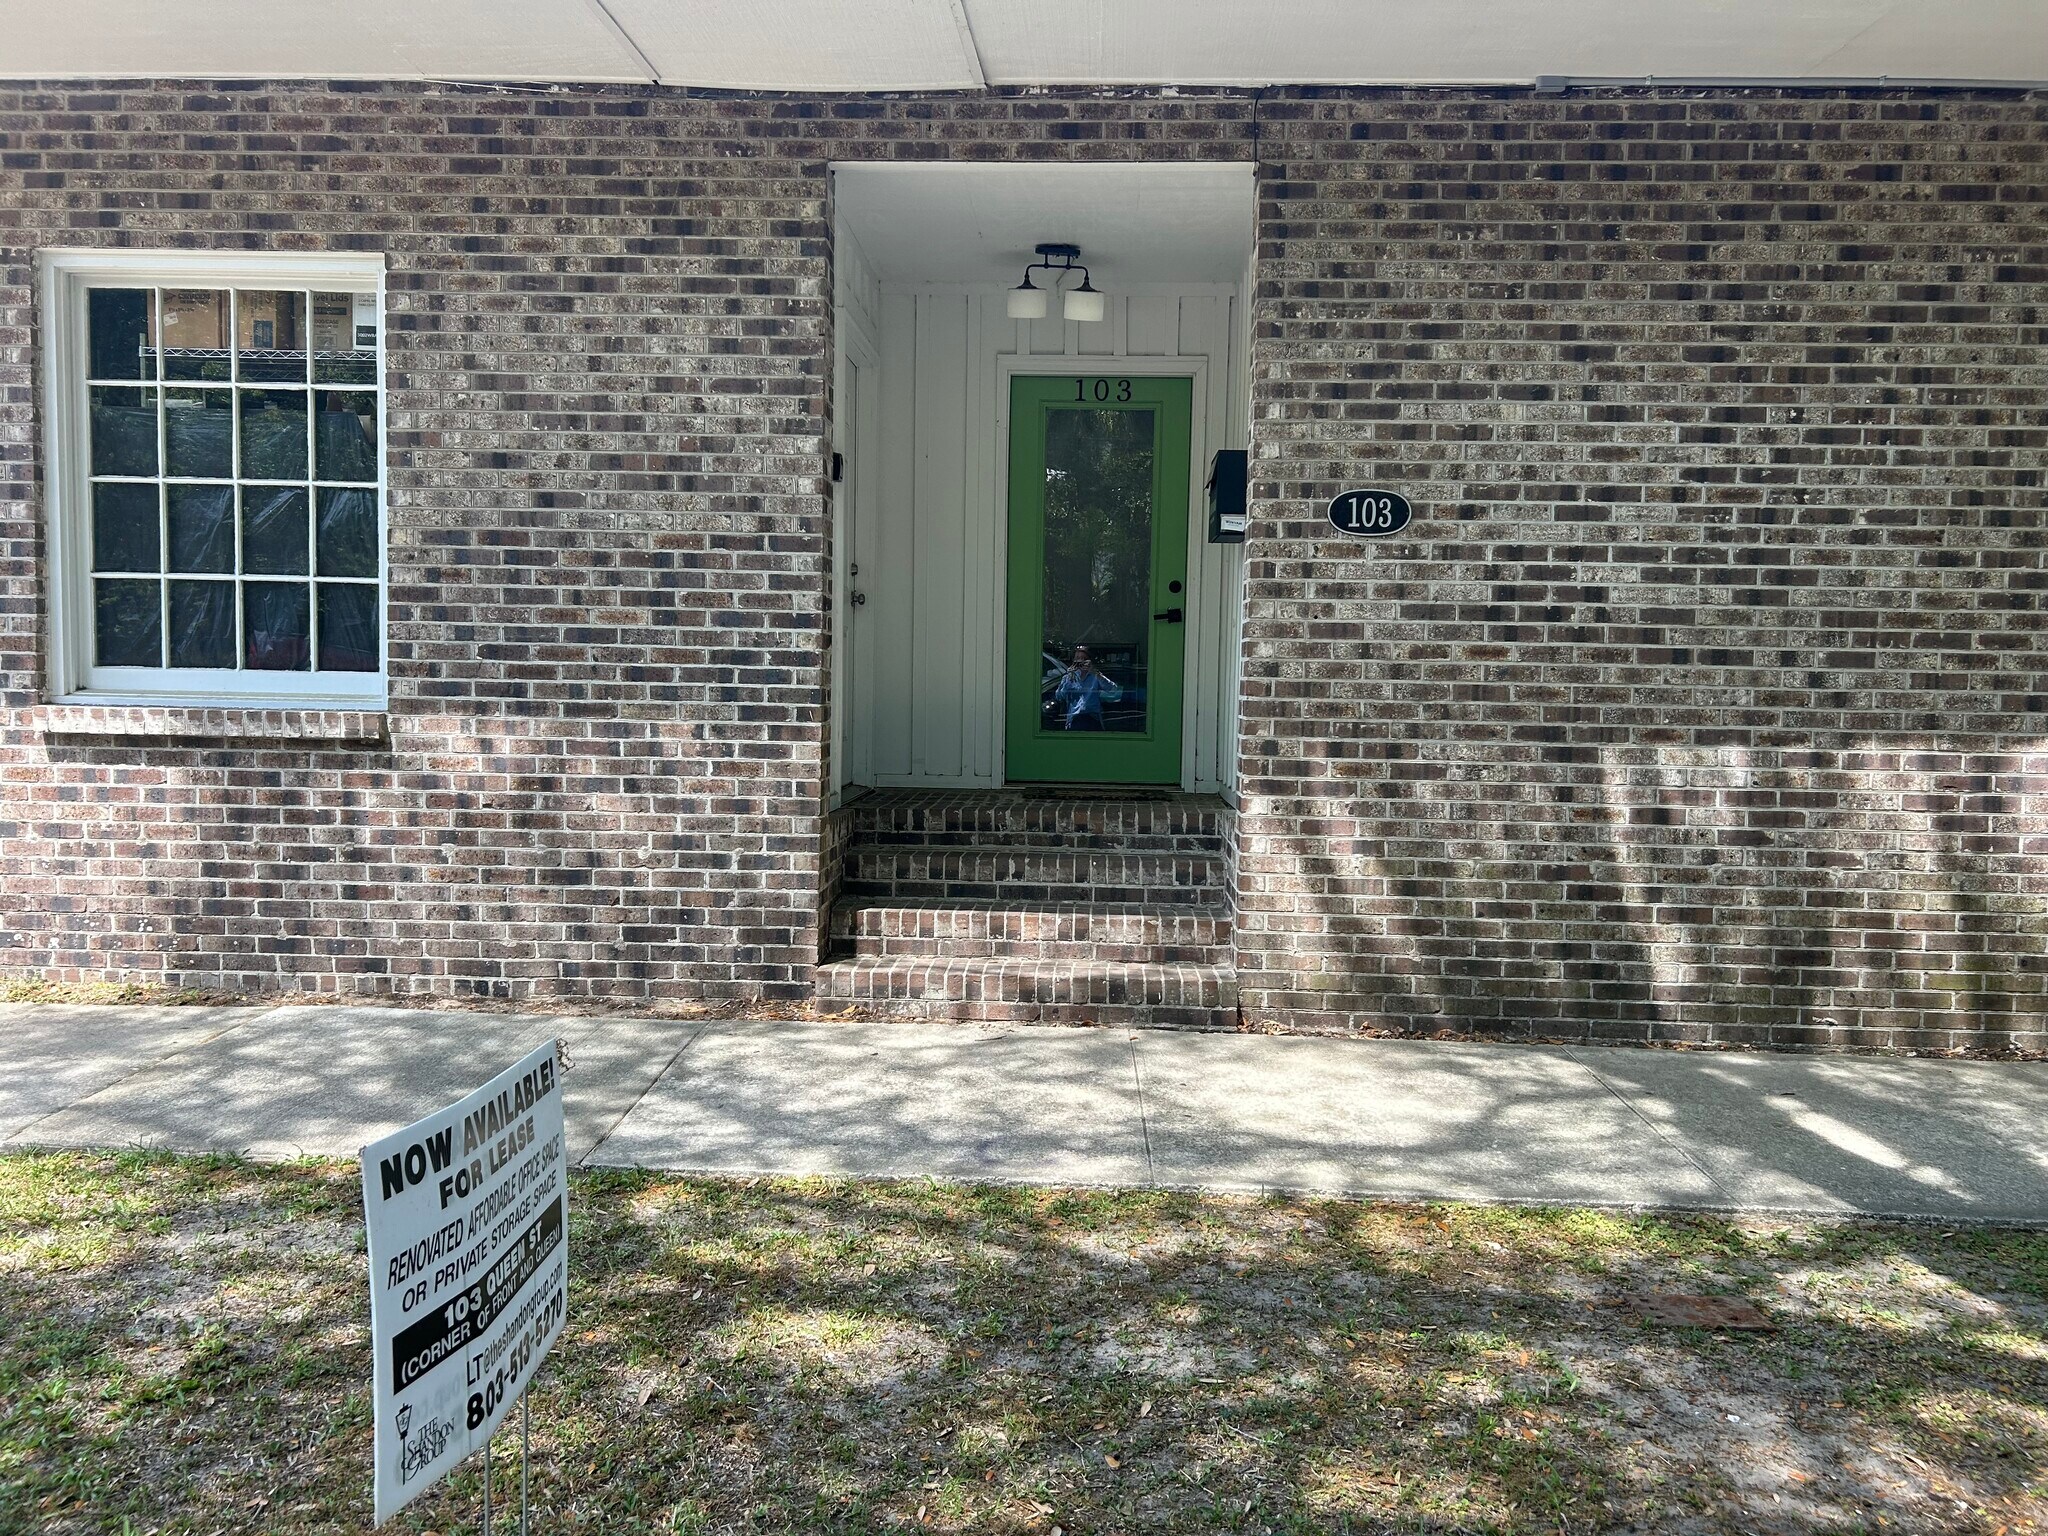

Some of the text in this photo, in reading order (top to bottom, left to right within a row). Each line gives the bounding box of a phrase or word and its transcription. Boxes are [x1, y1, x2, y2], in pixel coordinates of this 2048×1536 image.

[1074, 379, 1132, 402] 103
[1347, 498, 1392, 529] 103
[380, 1057, 555, 1201] NOW AVAILABLE!
[439, 1115, 535, 1210] FOR LEASE
[388, 1132, 560, 1290] RENOVATED AFFORDABLE OFFICE SPACE
[402, 1168, 557, 1313] OR PRIVATE STORAGE SPACE
[401, 1223, 560, 1384] (CORNER OF FRONT AND QUEEN)
[444, 1220, 543, 1329] 103 QUEEN ST
[467, 1261, 563, 1387] LT@theshandongroup.com
[466, 1287, 563, 1431] 803-513-5270
[402, 1438, 447, 1481] GROUP
[407, 1417, 455, 1460] SHANDON
[418, 1416, 438, 1440] THE
